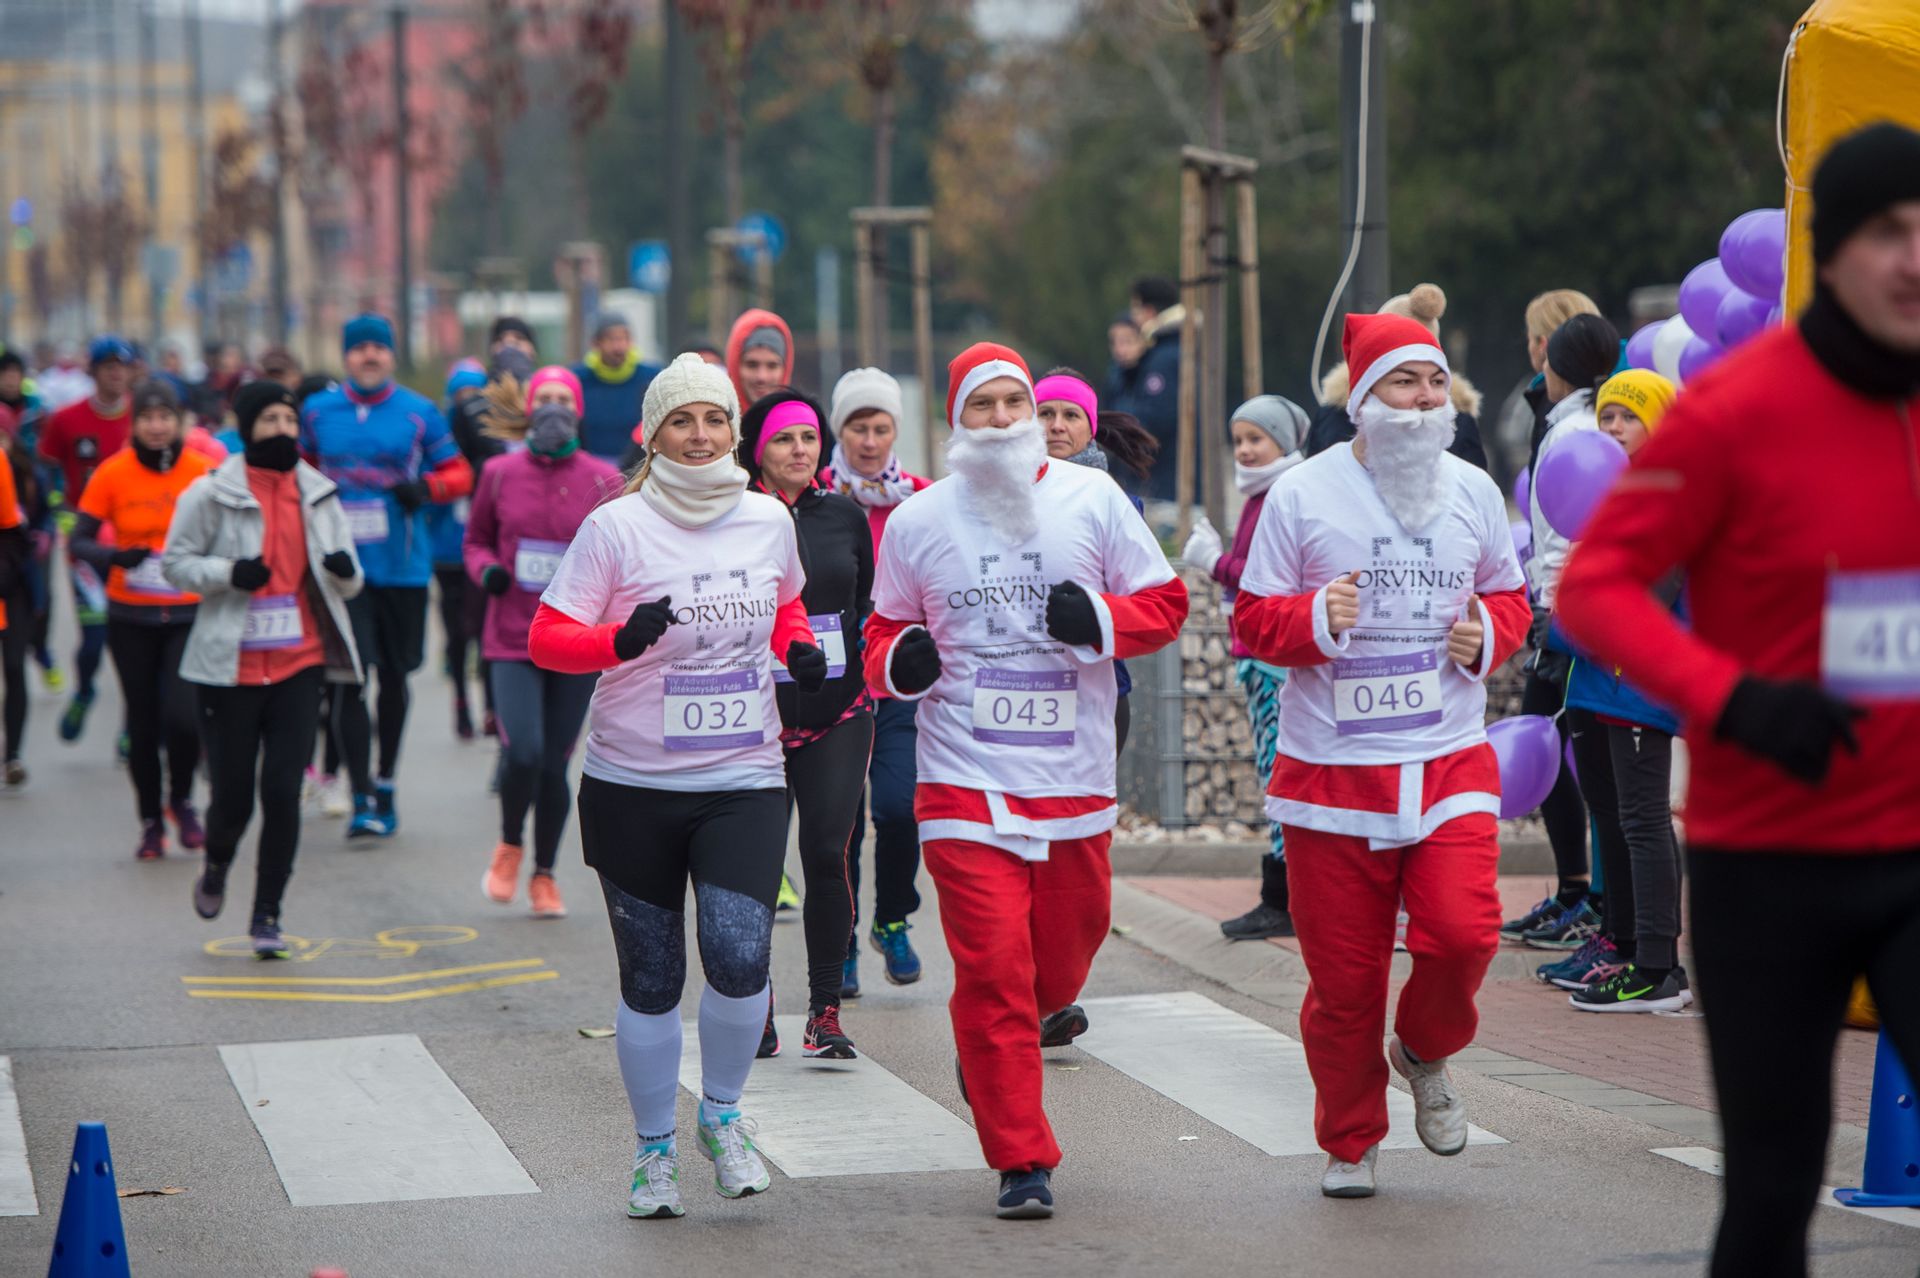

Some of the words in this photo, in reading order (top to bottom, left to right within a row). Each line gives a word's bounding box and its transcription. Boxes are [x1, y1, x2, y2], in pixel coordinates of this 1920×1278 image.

[1373, 560, 1435, 568] BUDAPESTI
[981, 575, 1044, 585] BUDAPESTI
[694, 591, 752, 603] BUDAPESTI
[947, 584, 1056, 610] CORVIN
[1373, 589, 1433, 597] EGYETEM
[672, 597, 776, 626] ORVINUS
[984, 603, 1044, 614] EGYETEM
[696, 621, 755, 632] EGYETEM
[1349, 632, 1417, 644] Székesfehérvári
[1392, 664, 1415, 673] Futás
[684, 677, 719, 686] Adventi
[723, 682, 742, 692] Futás
[1034, 681, 1056, 689] Futás
[1353, 680, 1424, 714] 046
[683, 699, 748, 731] 032
[992, 696, 1060, 726] 043
